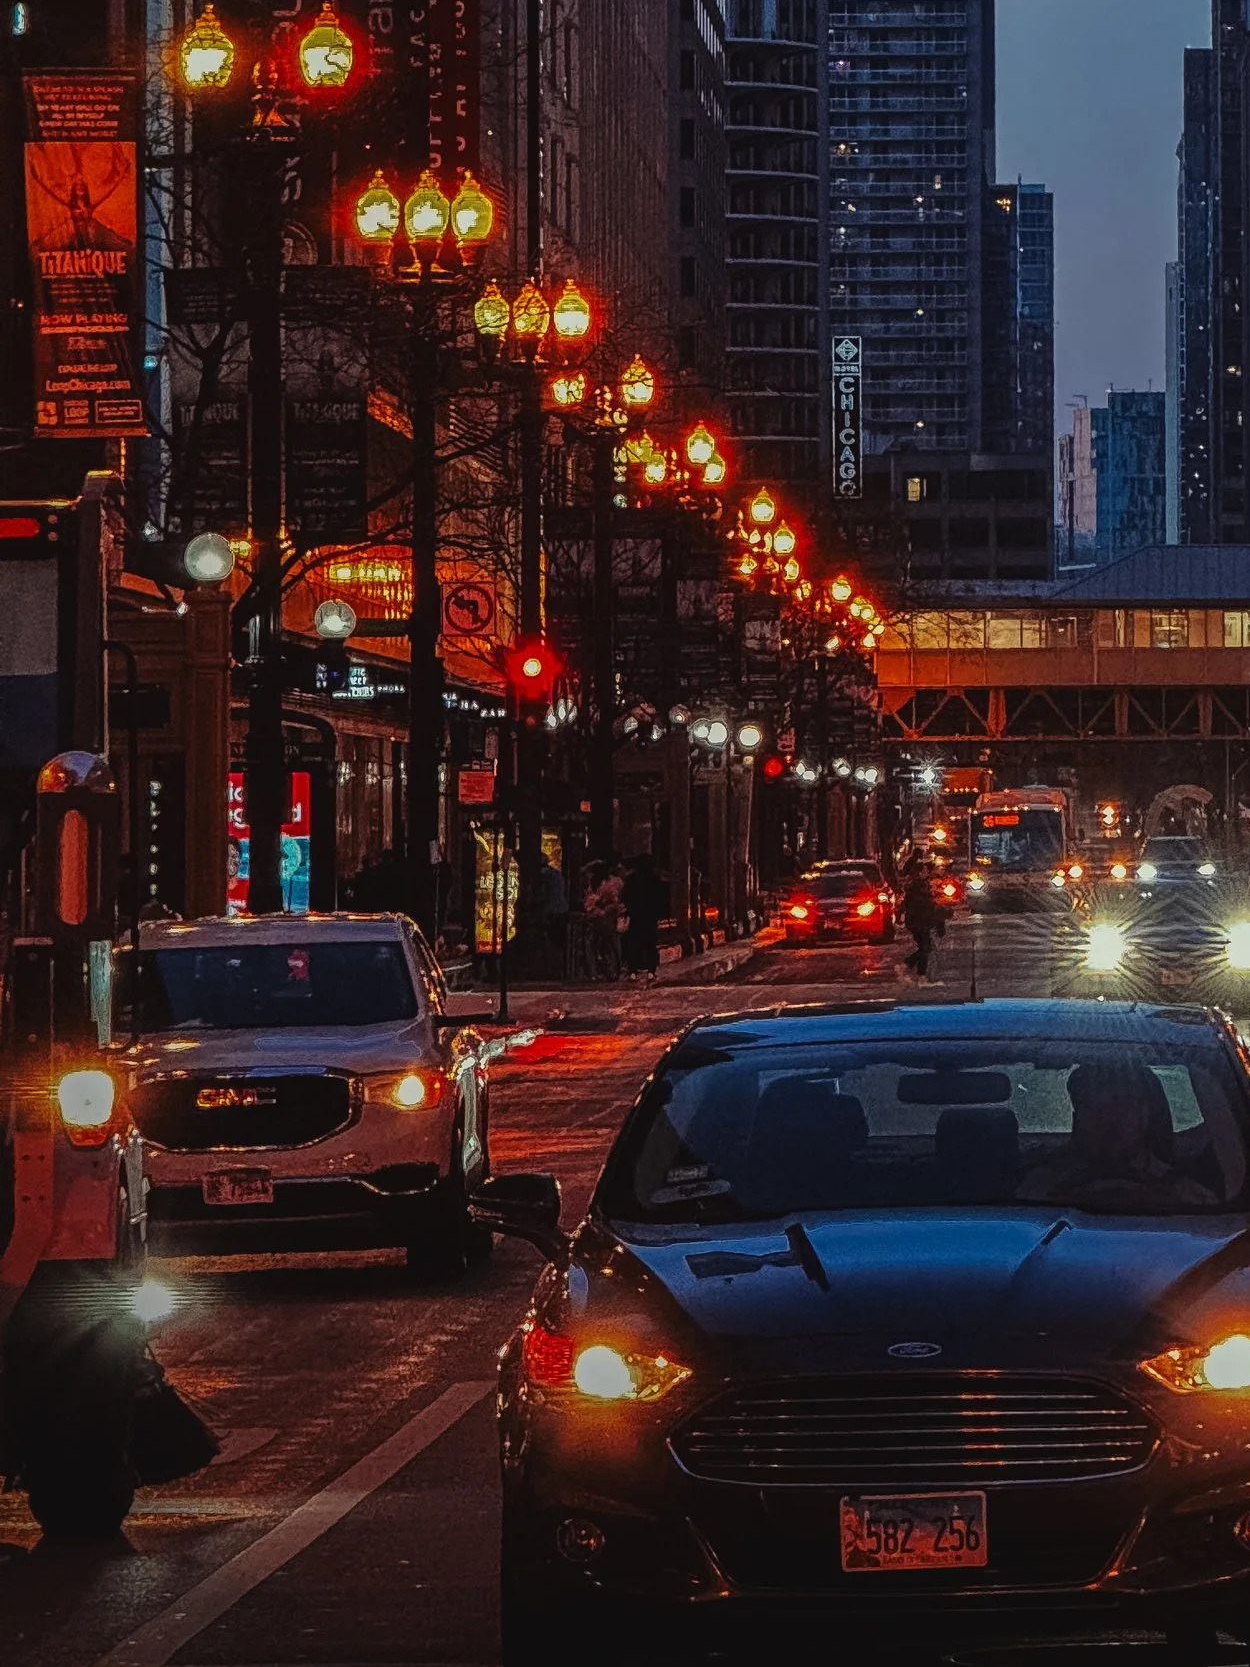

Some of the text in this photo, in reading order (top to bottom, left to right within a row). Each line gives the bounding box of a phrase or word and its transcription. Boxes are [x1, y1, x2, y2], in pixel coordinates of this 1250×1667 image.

[838, 376, 857, 497] CHICAGO
[866, 1515, 981, 1555] 582 256
